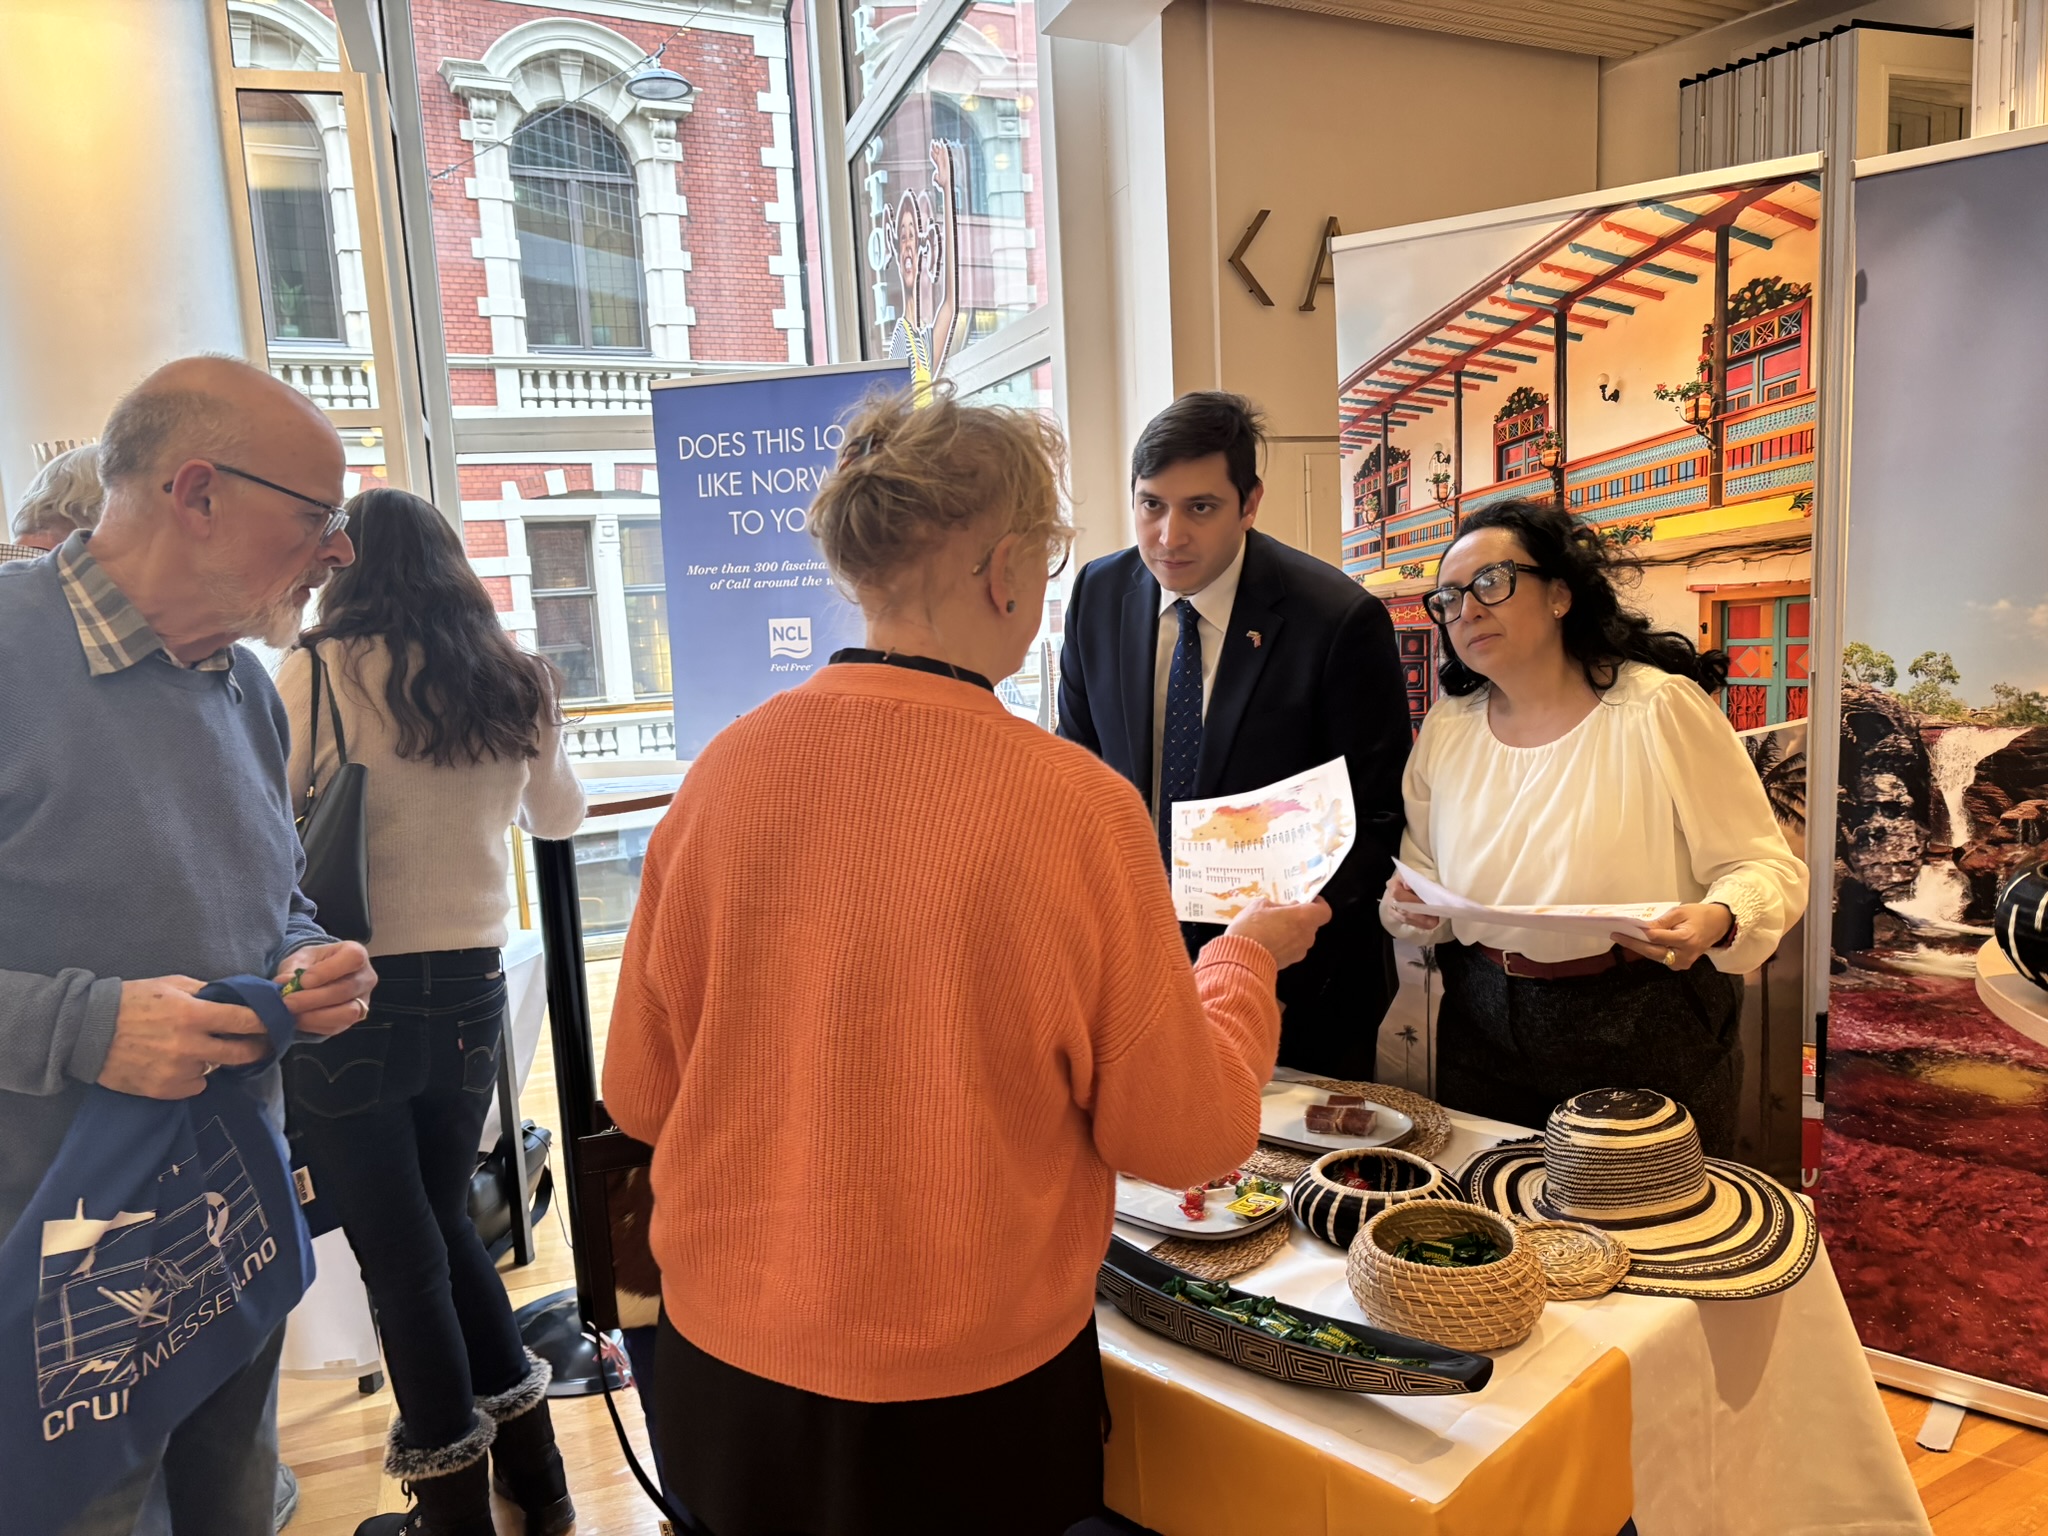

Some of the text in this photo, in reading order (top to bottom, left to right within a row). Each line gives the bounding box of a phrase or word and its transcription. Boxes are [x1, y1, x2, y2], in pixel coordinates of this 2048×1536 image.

[678, 424, 845, 460] DOES THIS LO
[698, 466, 829, 498] LIKE NORW
[728, 507, 807, 535] TO YO
[686, 559, 828, 576] More than 300 fascina
[709, 579, 724, 591] of
[726, 578, 750, 590] Call
[753, 576, 799, 588] around
[801, 575, 822, 587] the
[772, 626, 808, 641] NCL
[770, 663, 790, 672] Feel
